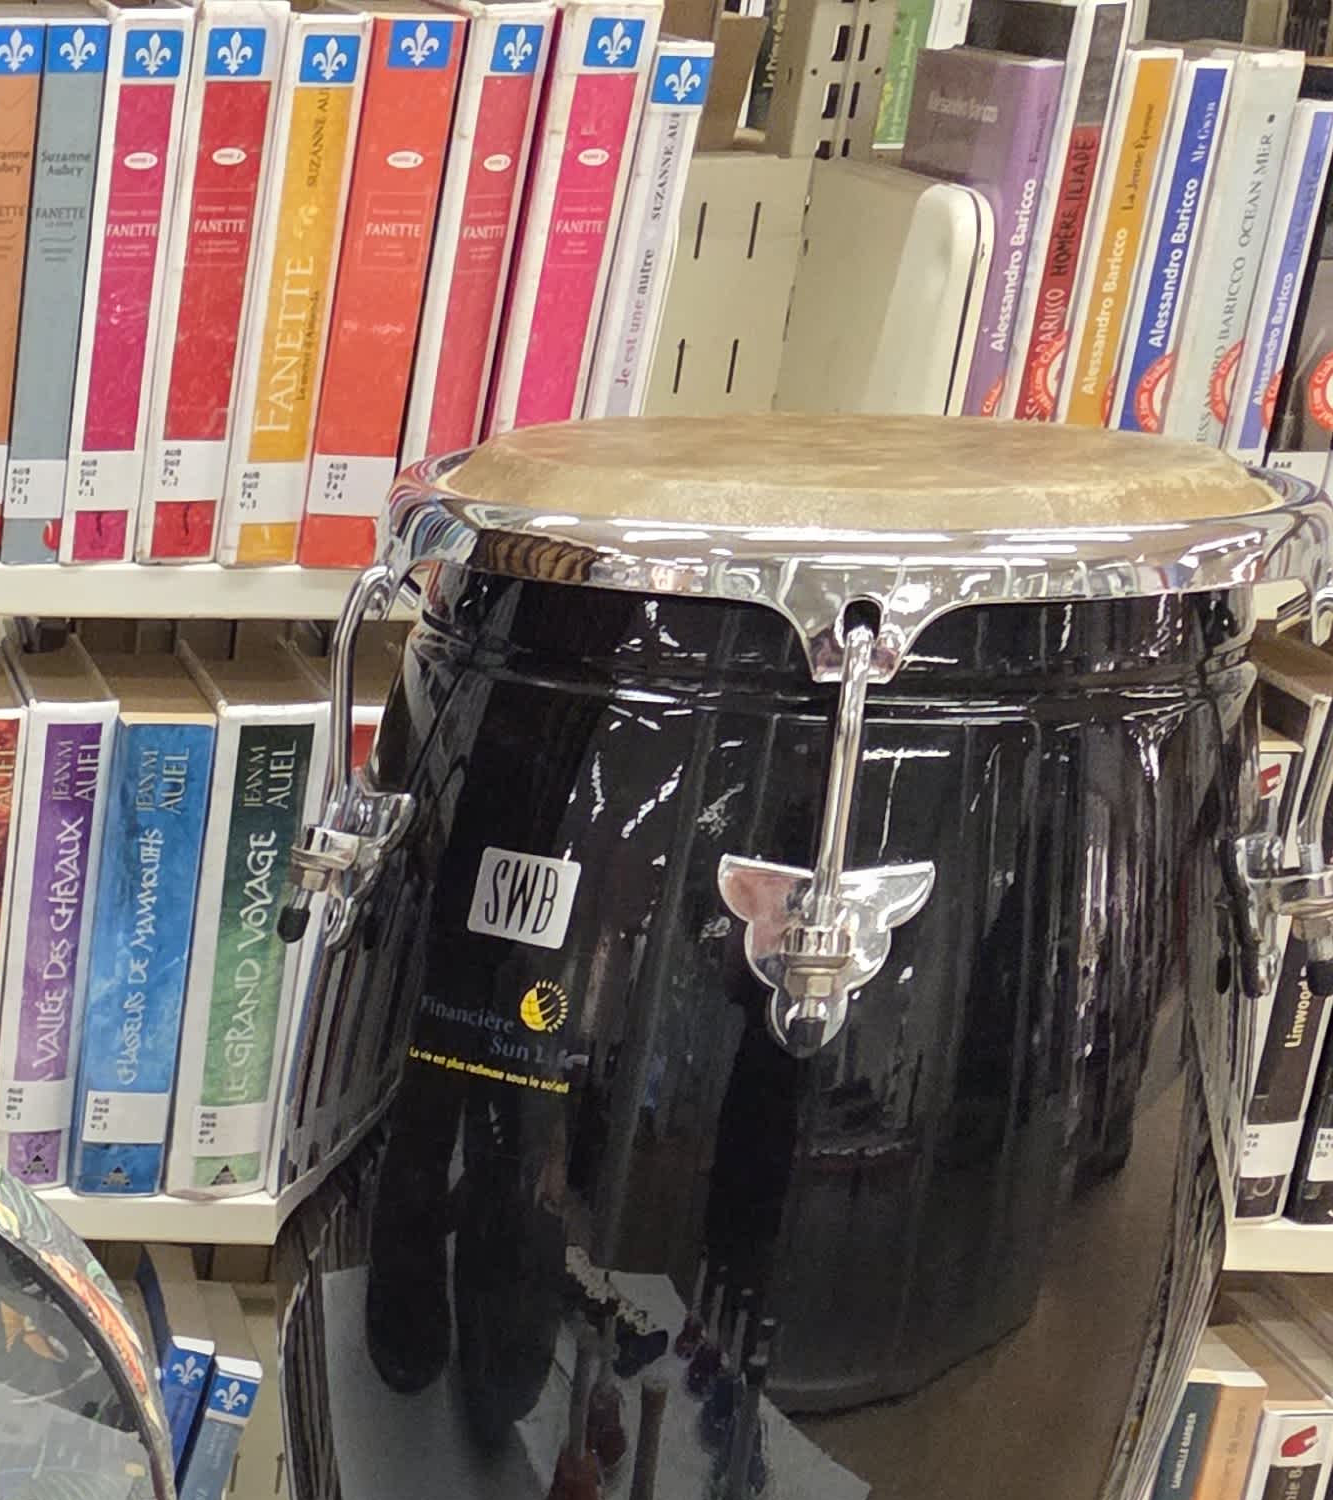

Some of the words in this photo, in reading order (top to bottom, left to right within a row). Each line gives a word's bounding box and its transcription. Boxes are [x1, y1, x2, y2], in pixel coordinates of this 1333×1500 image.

[1066, 136, 1095, 203] ILIADE
[107, 223, 158, 237] FANETTE
[194, 219, 246, 233] FANETTE
[365, 223, 422, 238] FANETTE
[555, 220, 605, 234] FANETTE
[637, 249, 654, 294] autre
[652, 148, 674, 221] SUZANNE
[253, 254, 316, 435] FANETTE
[306, 118, 326, 188] SUZANNE
[990, 249, 1022, 352] Alessandro
[1010, 178, 1037, 247] Baricco
[1148, 250, 1182, 349] Alessandro
[1171, 178, 1198, 247] Baricco
[1272, 272, 1293, 317] Baricco
[1082, 297, 1114, 396] Alessandro
[1103, 227, 1128, 296] Baricco
[1217, 256, 1246, 341] BARICCO
[74, 744, 101, 800] AUEL
[158, 747, 191, 814] AUEL
[266, 740, 298, 809] AUEL
[48, 816, 84, 931] CHEVAUX
[130, 828, 166, 951] MAMMOUTHS
[237, 830, 277, 951] VOYAGE
[484, 858, 558, 935] SWB
[42, 939, 71, 981] DES
[128, 957, 148, 985] DE
[33, 989, 67, 1068] VALLÉE
[117, 991, 147, 1085] CHASSEURS
[225, 959, 262, 1068] GRAND
[419, 995, 516, 1034] Financière
[420, 1051, 432, 1062] vie
[446, 1056, 465, 1071] plus
[505, 1071, 528, 1086] sous
[541, 1079, 570, 1094] soleil
[490, 1037, 529, 1060] Sun
[225, 1074, 246, 1101] LE
